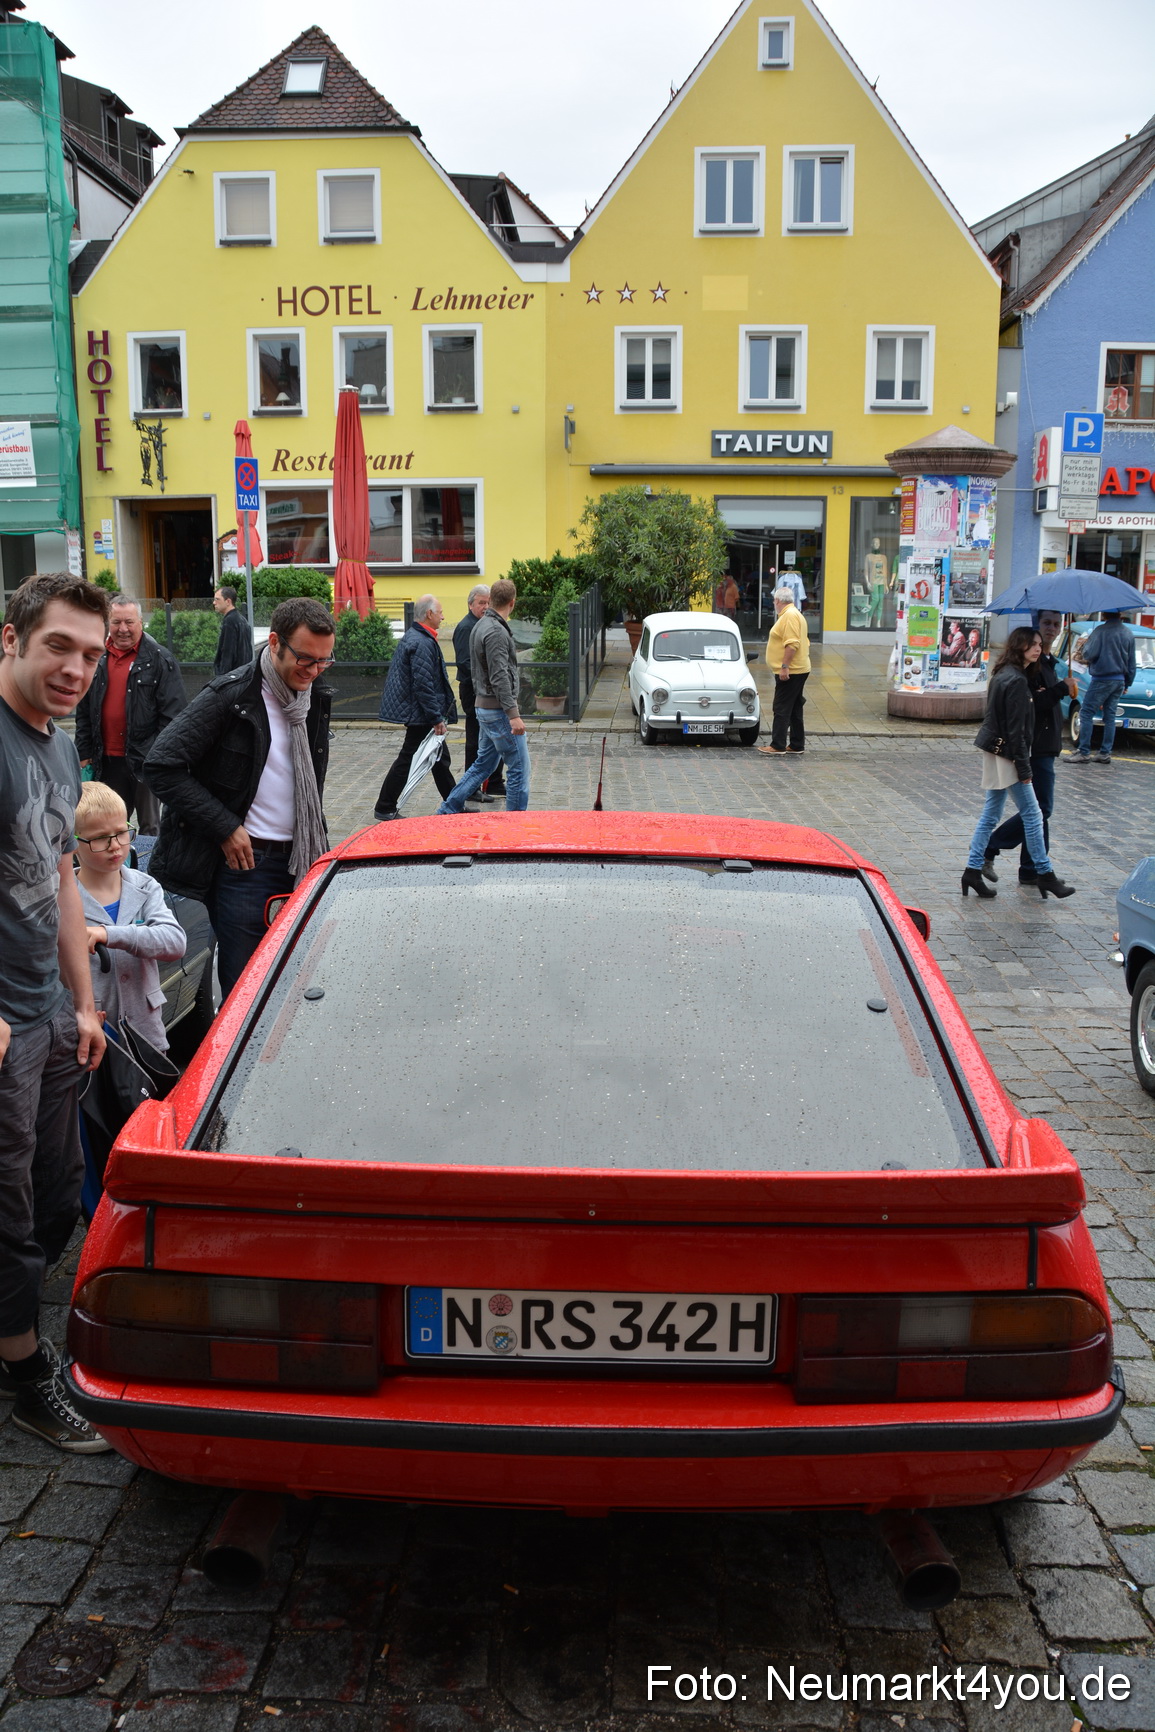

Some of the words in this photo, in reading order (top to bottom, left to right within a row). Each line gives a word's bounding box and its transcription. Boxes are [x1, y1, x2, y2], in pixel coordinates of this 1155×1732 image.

[277, 284, 382, 317] HOTEL
[409, 286, 535, 312] Lehmeier
[87, 330, 114, 472] HOTEL
[1072, 417, 1095, 448] P
[715, 434, 828, 453] TAIFUN
[270, 448, 415, 472] Restrant
[832, 485, 844, 495] 13
[1099, 467, 1155, 495] AP
[237, 494, 258, 506] TAXI
[687, 724, 698, 732] NM
[703, 724, 713, 732] BE
[714, 724, 725, 732] 5H
[1139, 720, 1149, 728] SU
[447, 1297, 482, 1348] N
[521, 1298, 597, 1351] RS
[420, 1327, 433, 1343] D
